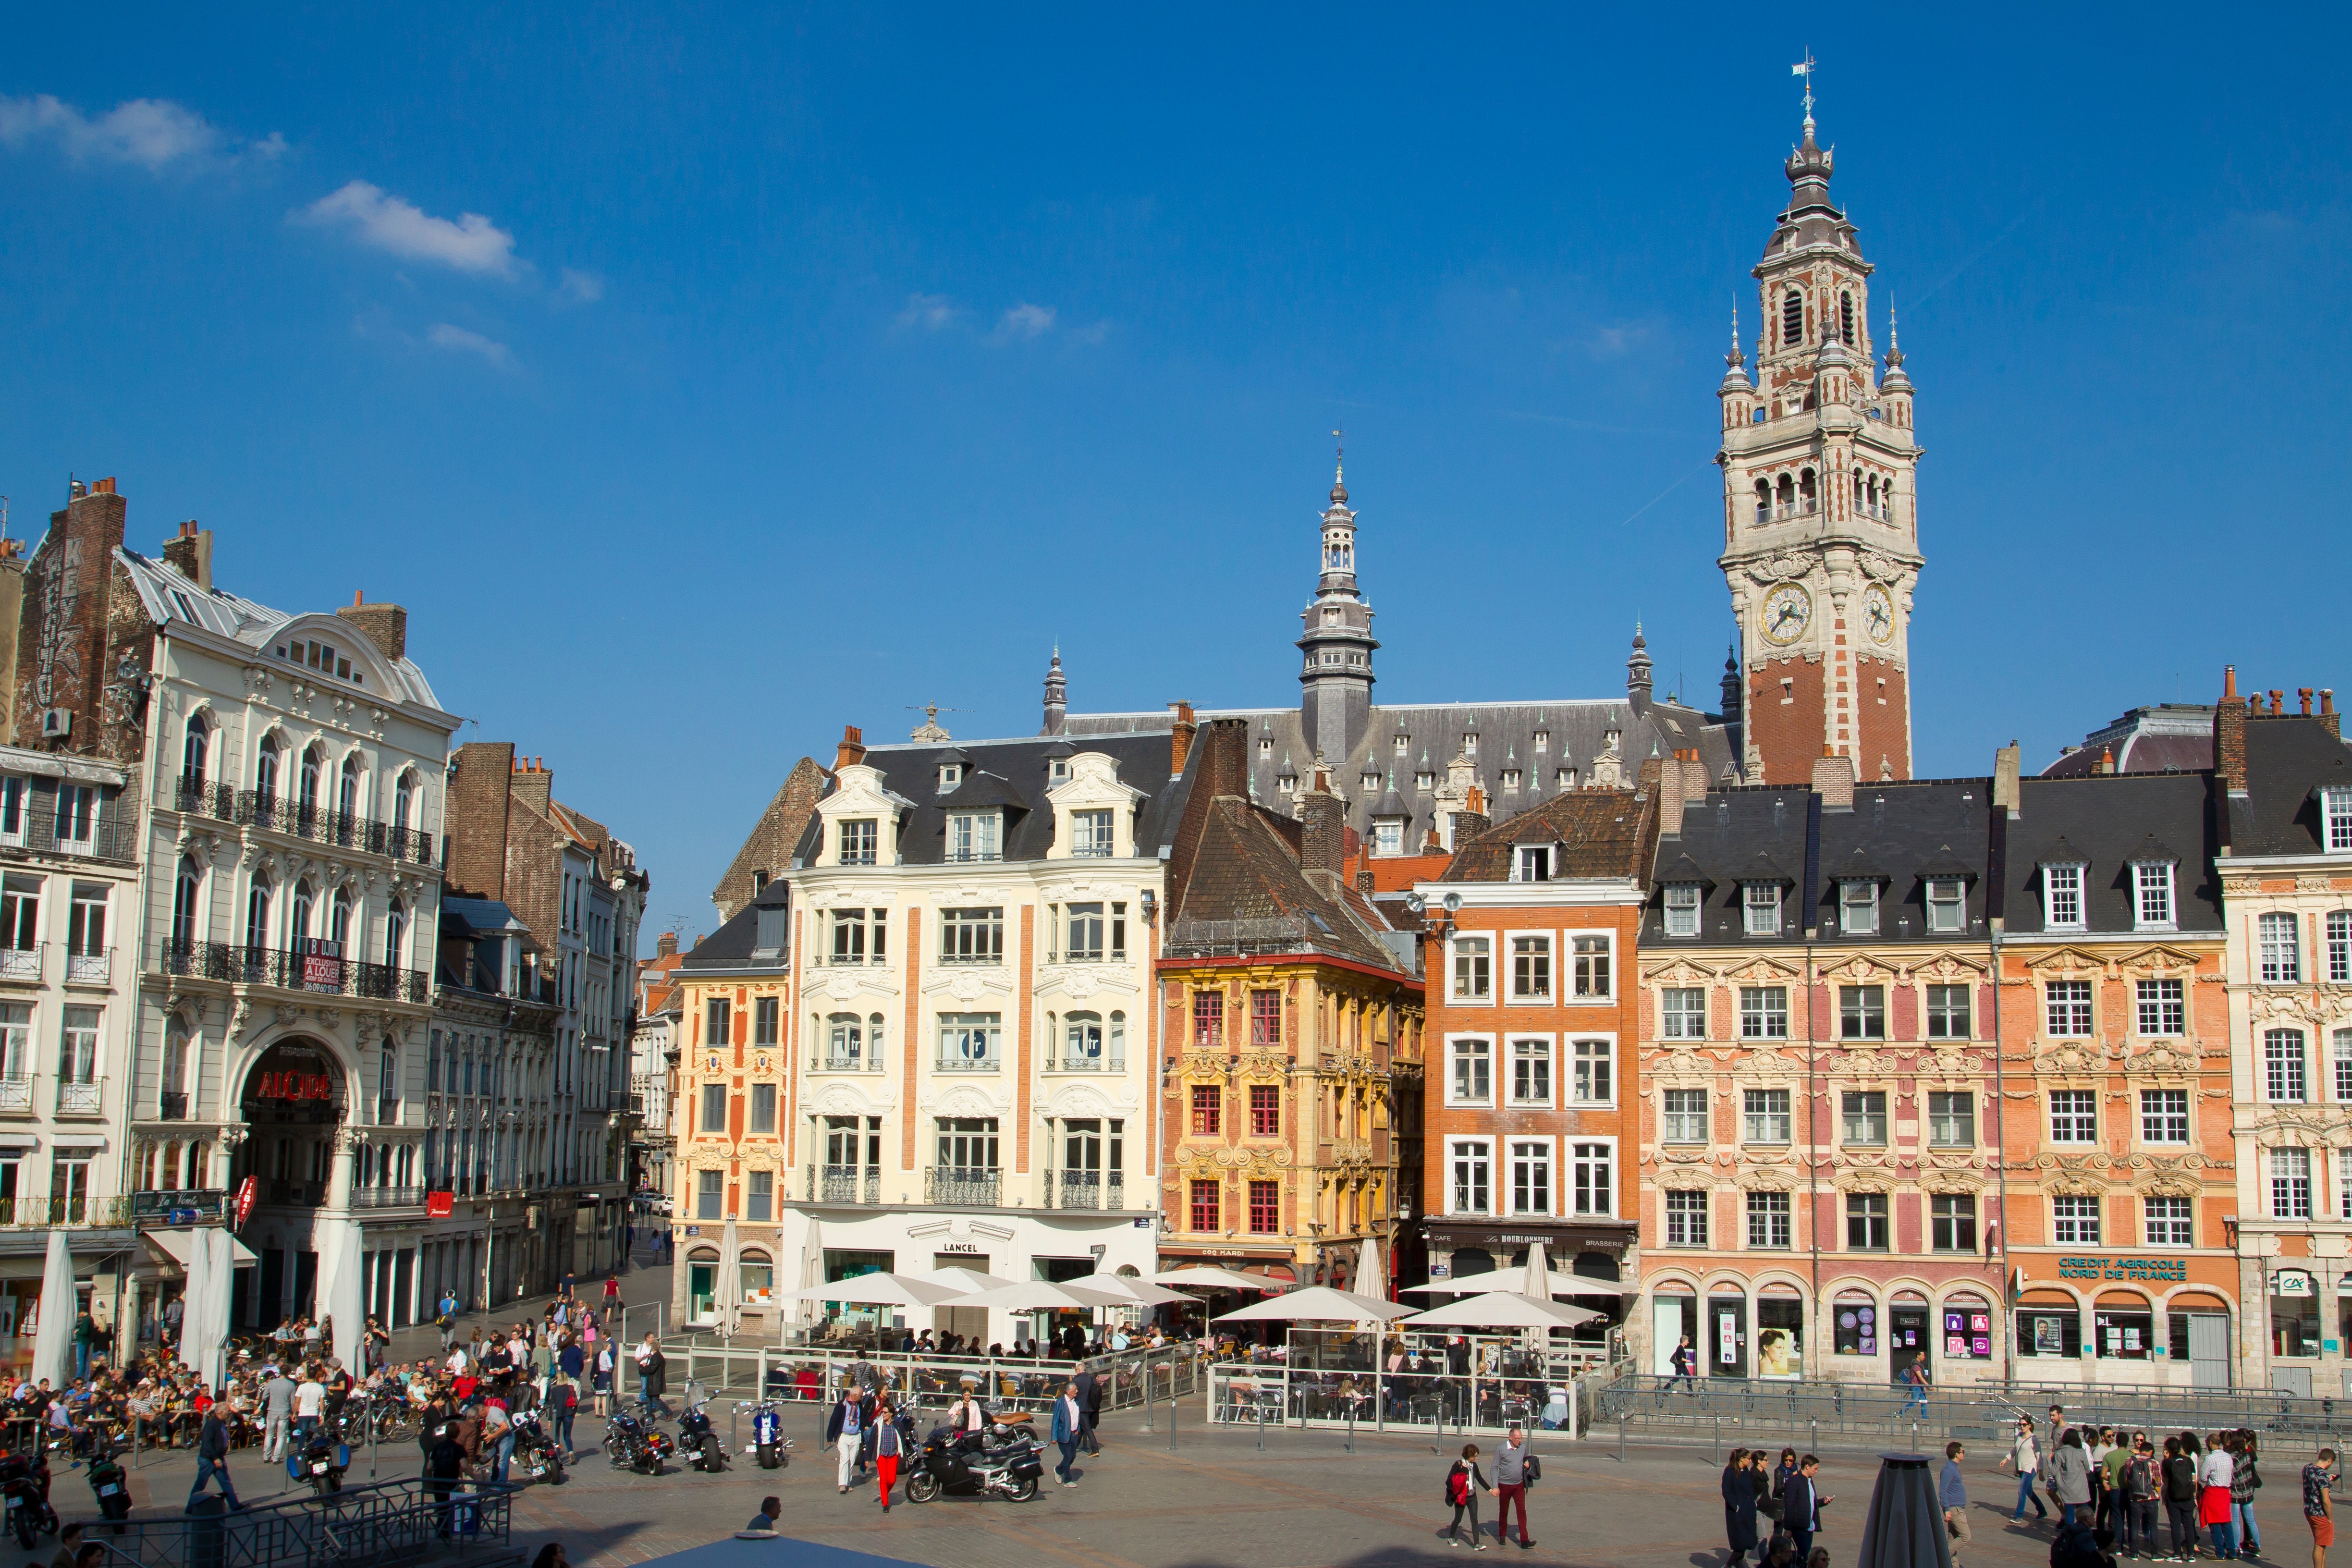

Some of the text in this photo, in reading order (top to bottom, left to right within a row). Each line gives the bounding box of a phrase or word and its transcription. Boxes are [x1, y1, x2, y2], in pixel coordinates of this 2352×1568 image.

[306, 965, 339, 979] A LOUER
[306, 982, 312, 991] 06
[320, 984, 327, 993] 60
[257, 1069, 331, 1101] ALCIDE
[242, 1183, 253, 1214] TABAC
[944, 1243, 977, 1252] LANCEL
[2059, 1257, 2187, 1270] CREDIT AGRICOLE
[2059, 1268, 2187, 1281] NORD DE FRANCE
